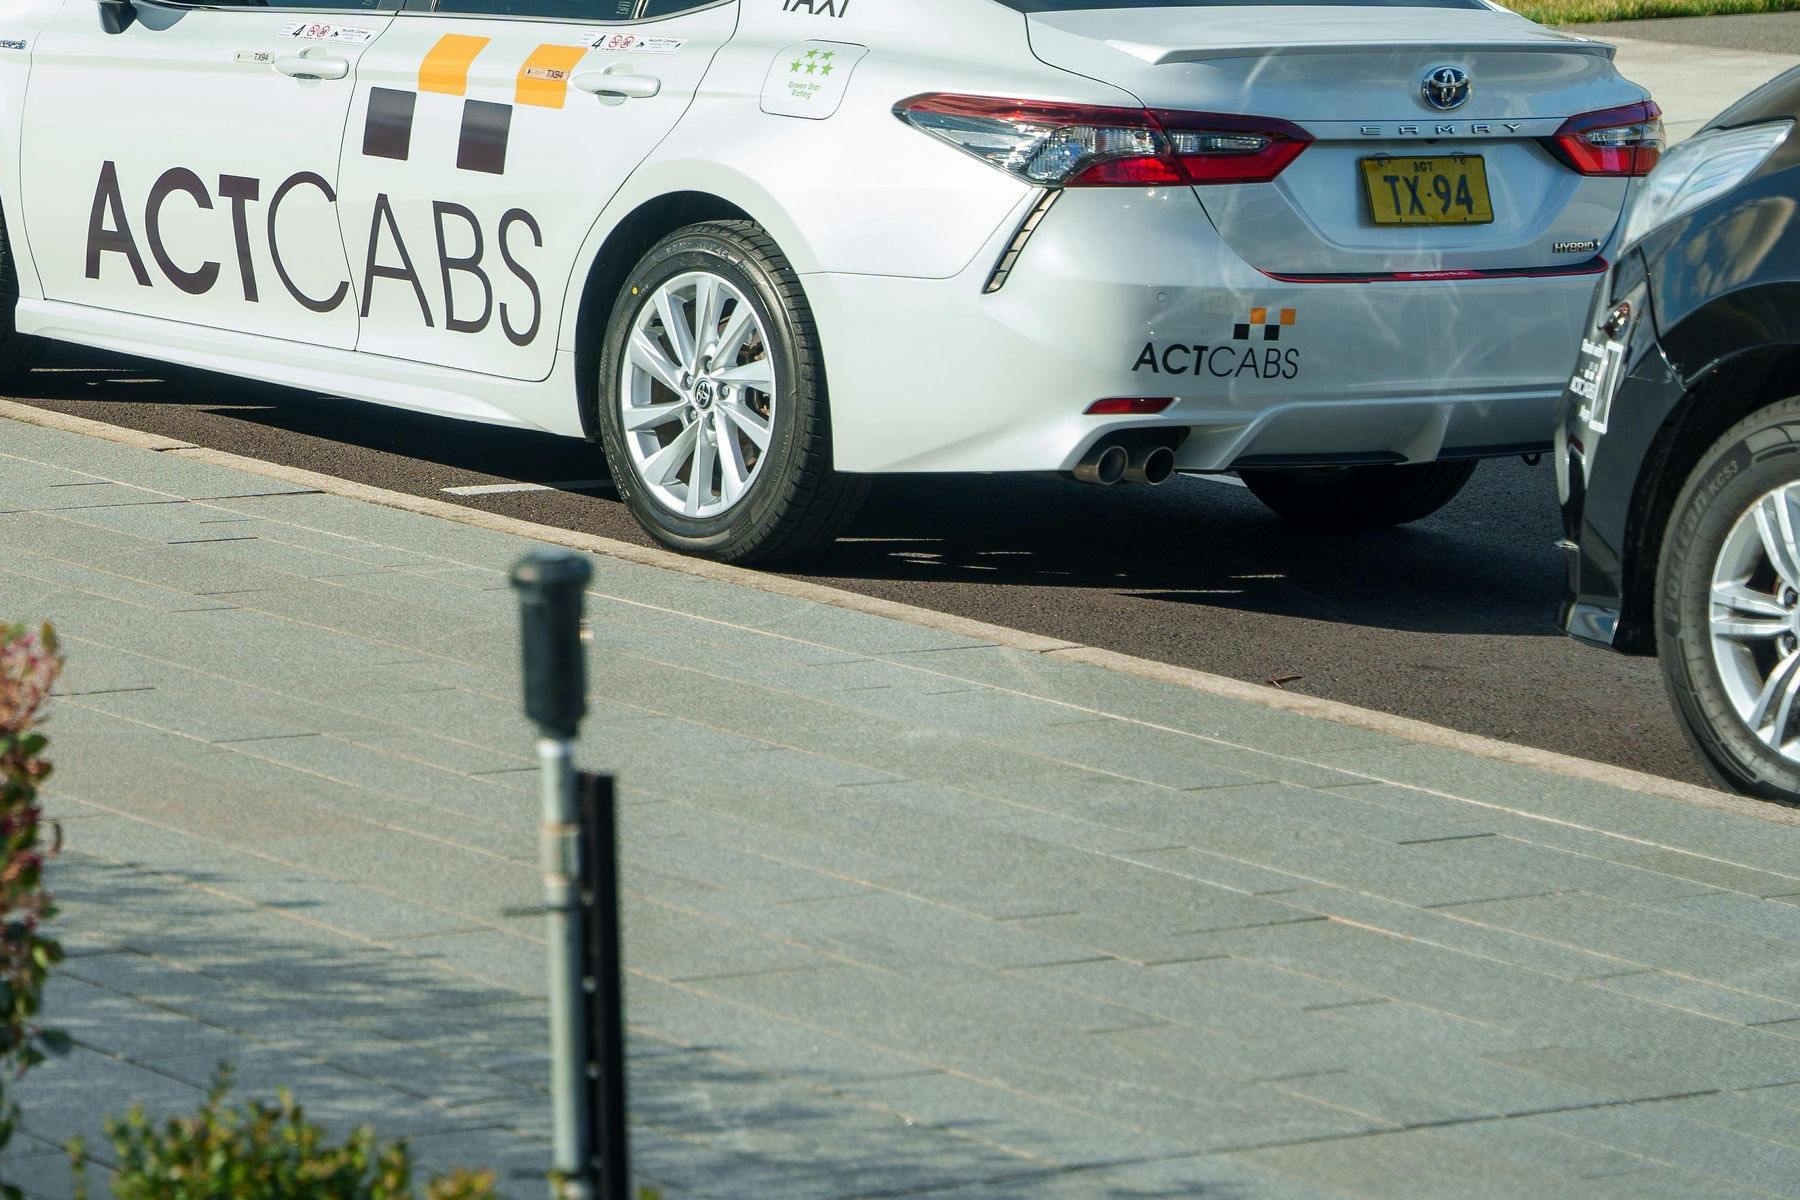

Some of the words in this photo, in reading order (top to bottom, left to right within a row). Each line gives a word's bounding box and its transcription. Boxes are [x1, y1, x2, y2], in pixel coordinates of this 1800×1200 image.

[1360, 123, 1523, 135] CAMRY
[84, 160, 544, 347] ACTCABS
[1131, 342, 1300, 380] ACTCABS
